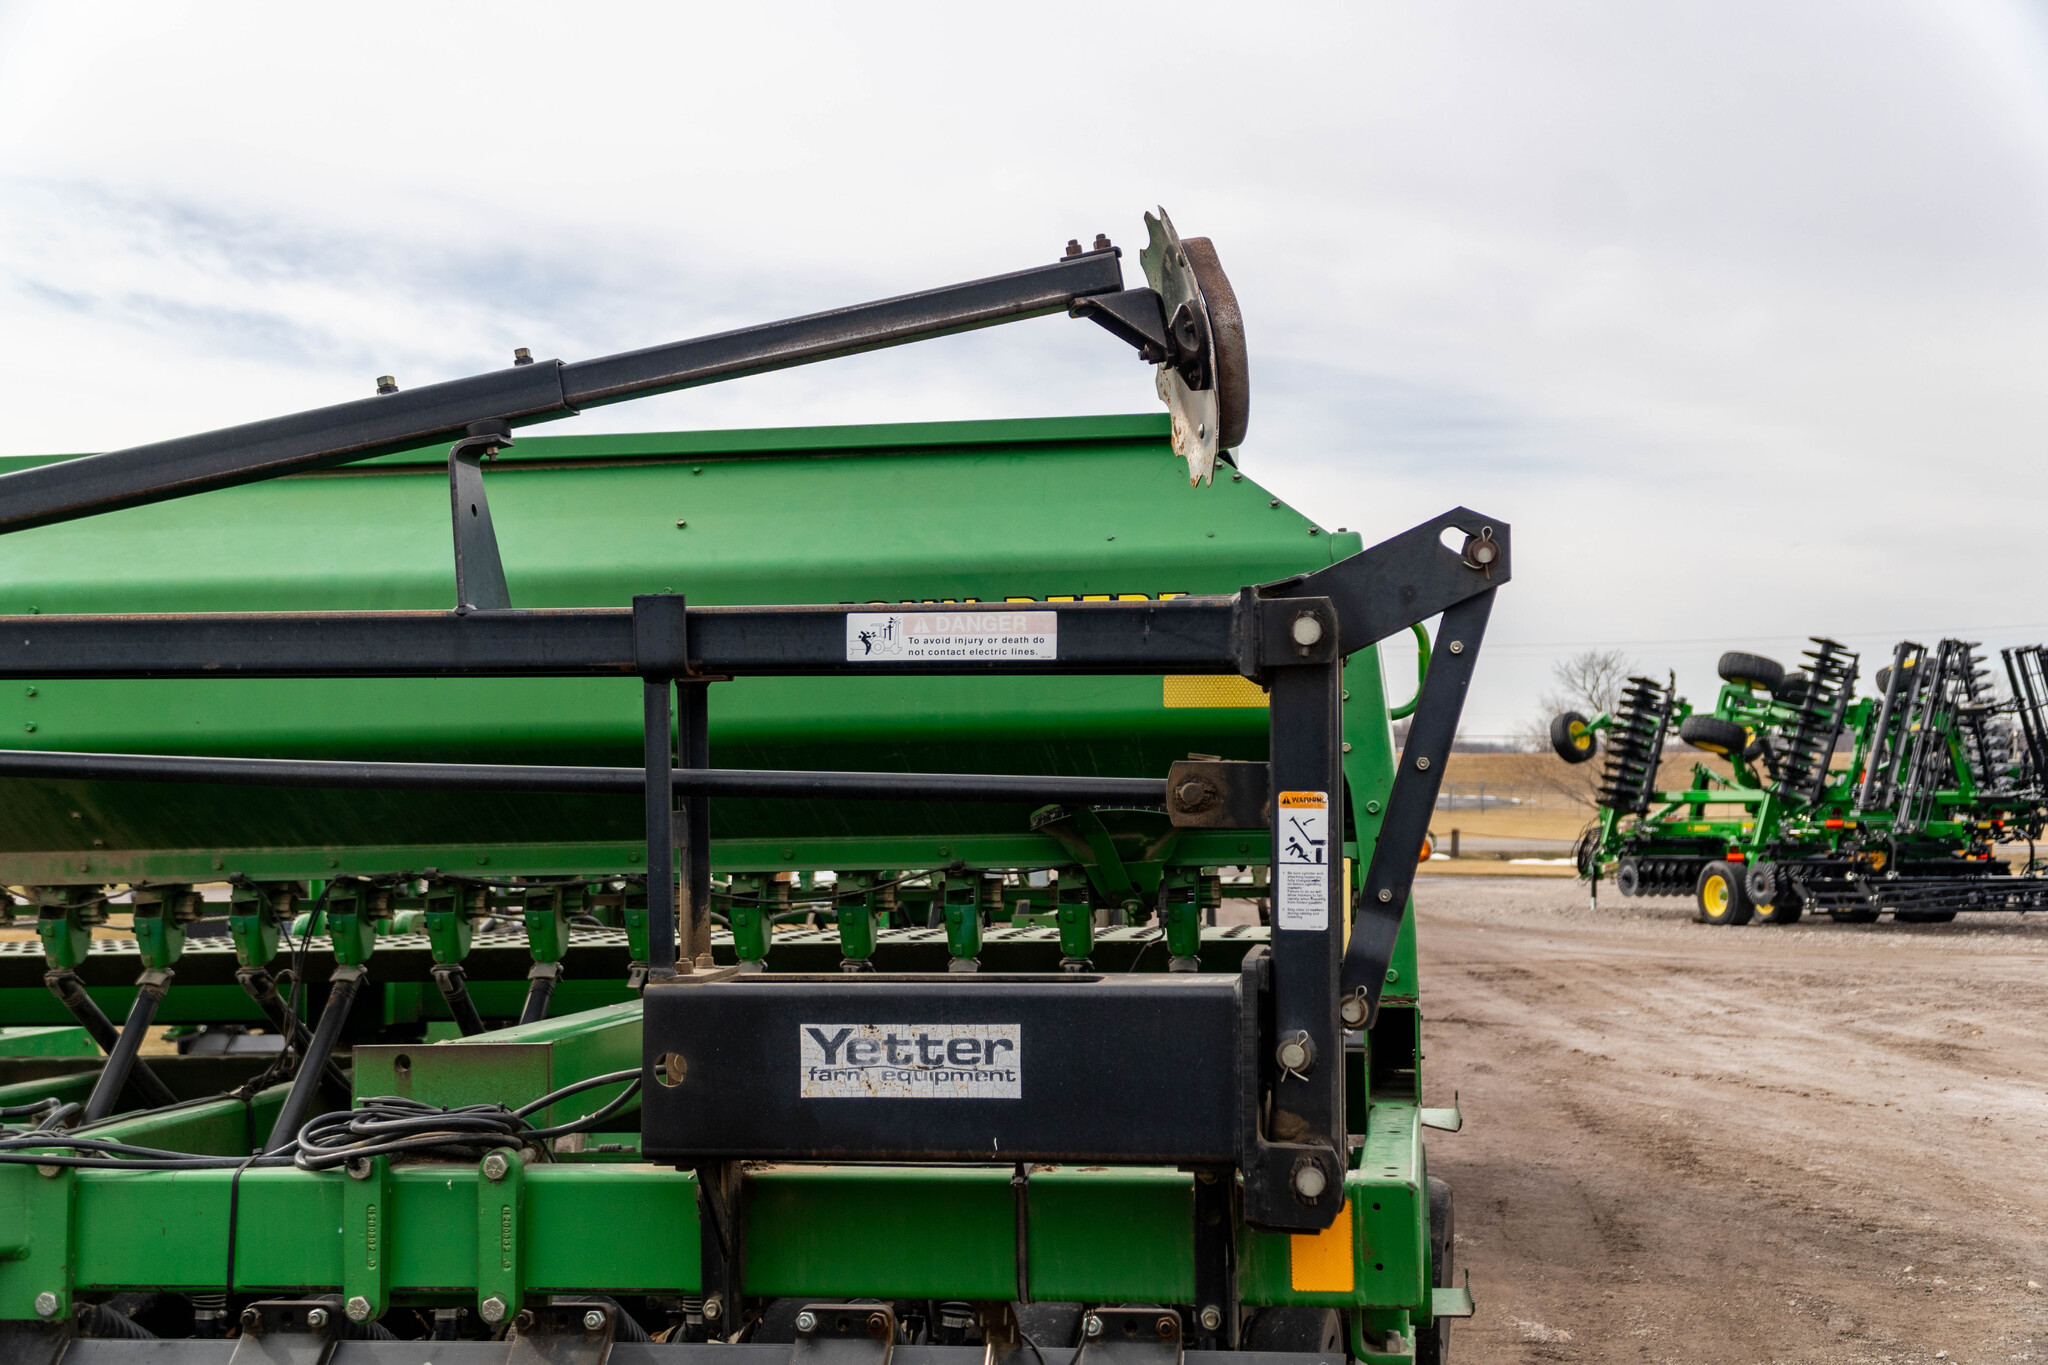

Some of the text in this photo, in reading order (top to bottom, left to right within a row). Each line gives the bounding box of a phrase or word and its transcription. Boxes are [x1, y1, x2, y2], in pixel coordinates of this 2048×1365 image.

[936, 615, 1027, 632] DANGER
[923, 636, 951, 645] avoid
[954, 636, 984, 646] injury
[1001, 636, 1029, 644] death
[1033, 636, 1045, 644] do
[908, 647, 1039, 656] not contact electric lines.
[805, 1028, 1014, 1066] Yetter
[809, 1067, 1016, 1086] farm equipment
